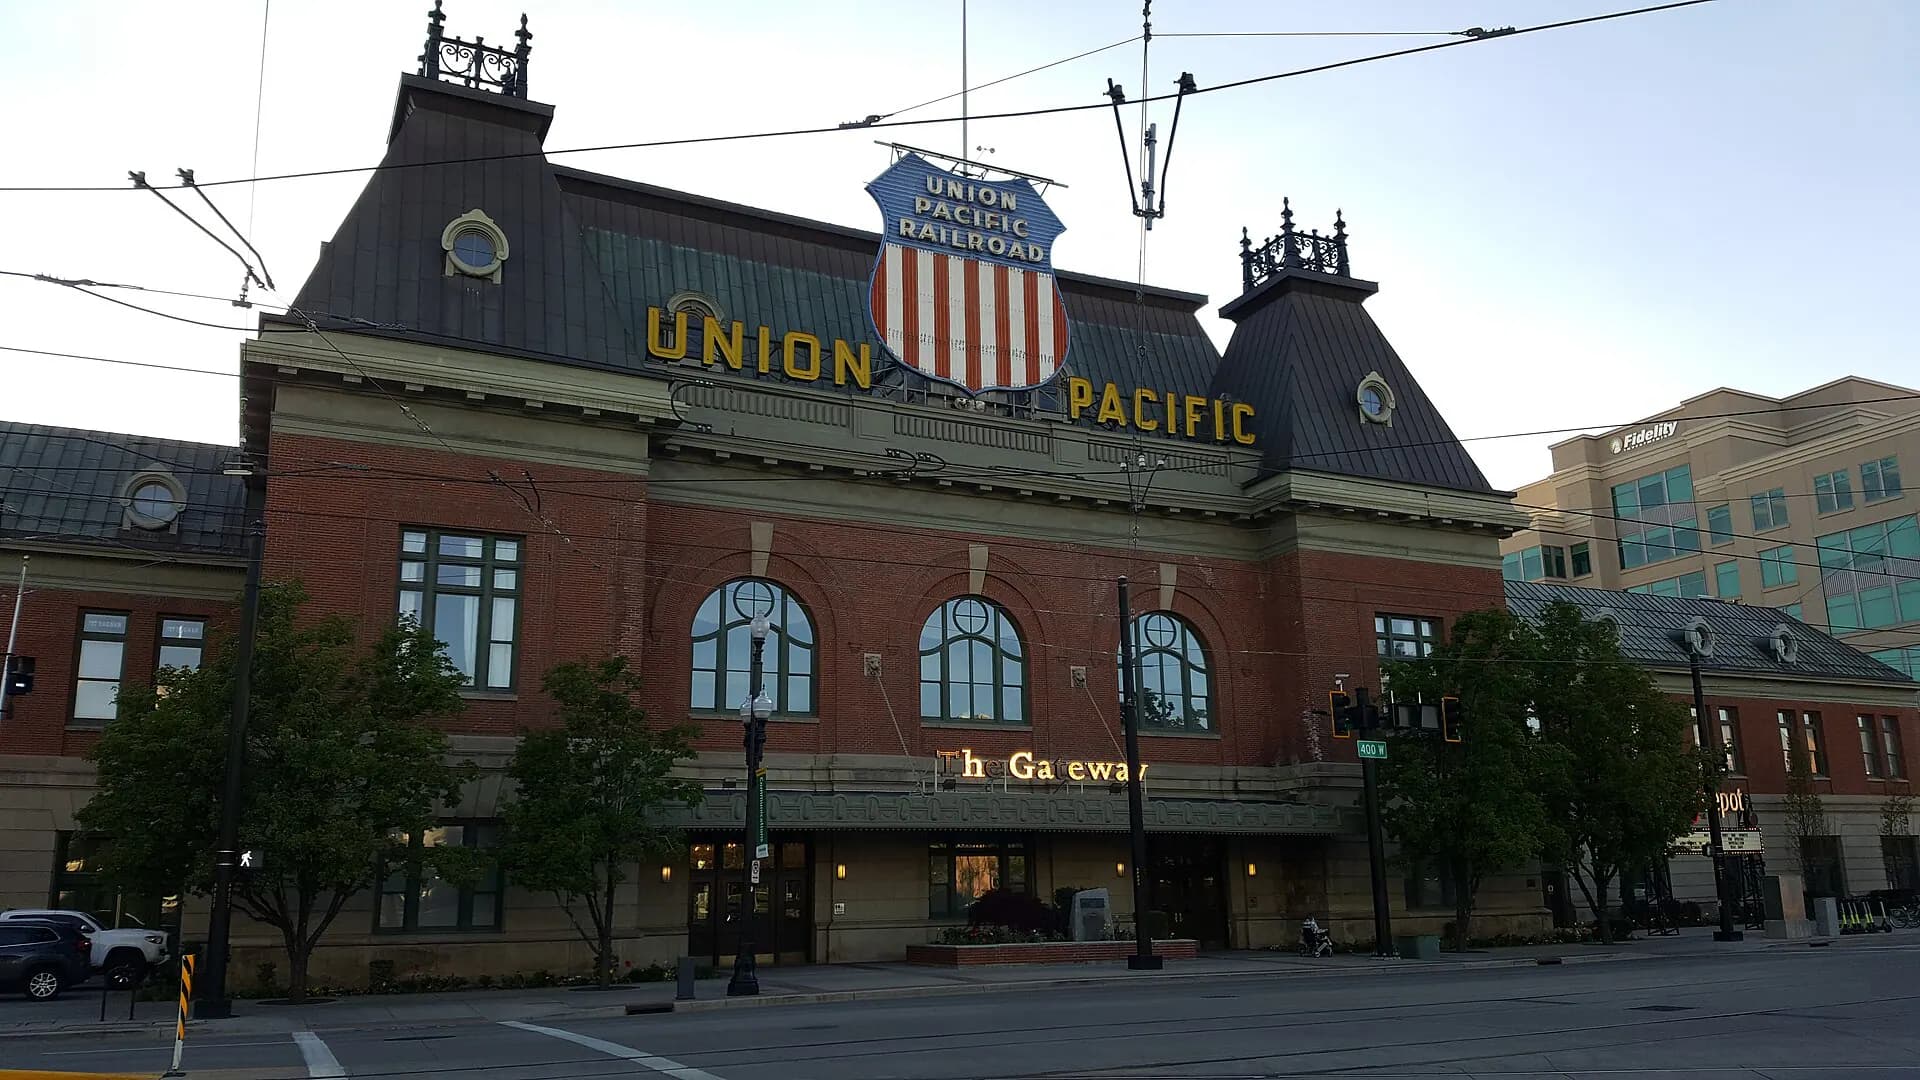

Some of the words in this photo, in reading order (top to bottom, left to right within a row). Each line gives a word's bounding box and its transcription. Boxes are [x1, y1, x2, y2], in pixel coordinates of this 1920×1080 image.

[926, 174, 1017, 211] UNION
[915, 195, 1029, 238] PACIFIC
[899, 218, 1044, 262] RAILROAD
[647, 305, 872, 389] UNION
[1068, 376, 1256, 444] PACIFIC
[1623, 420, 1678, 448] Fidelity
[936, 749, 1001, 777] The
[1360, 744, 1376, 755] 400
[1377, 744, 1385, 755] W
